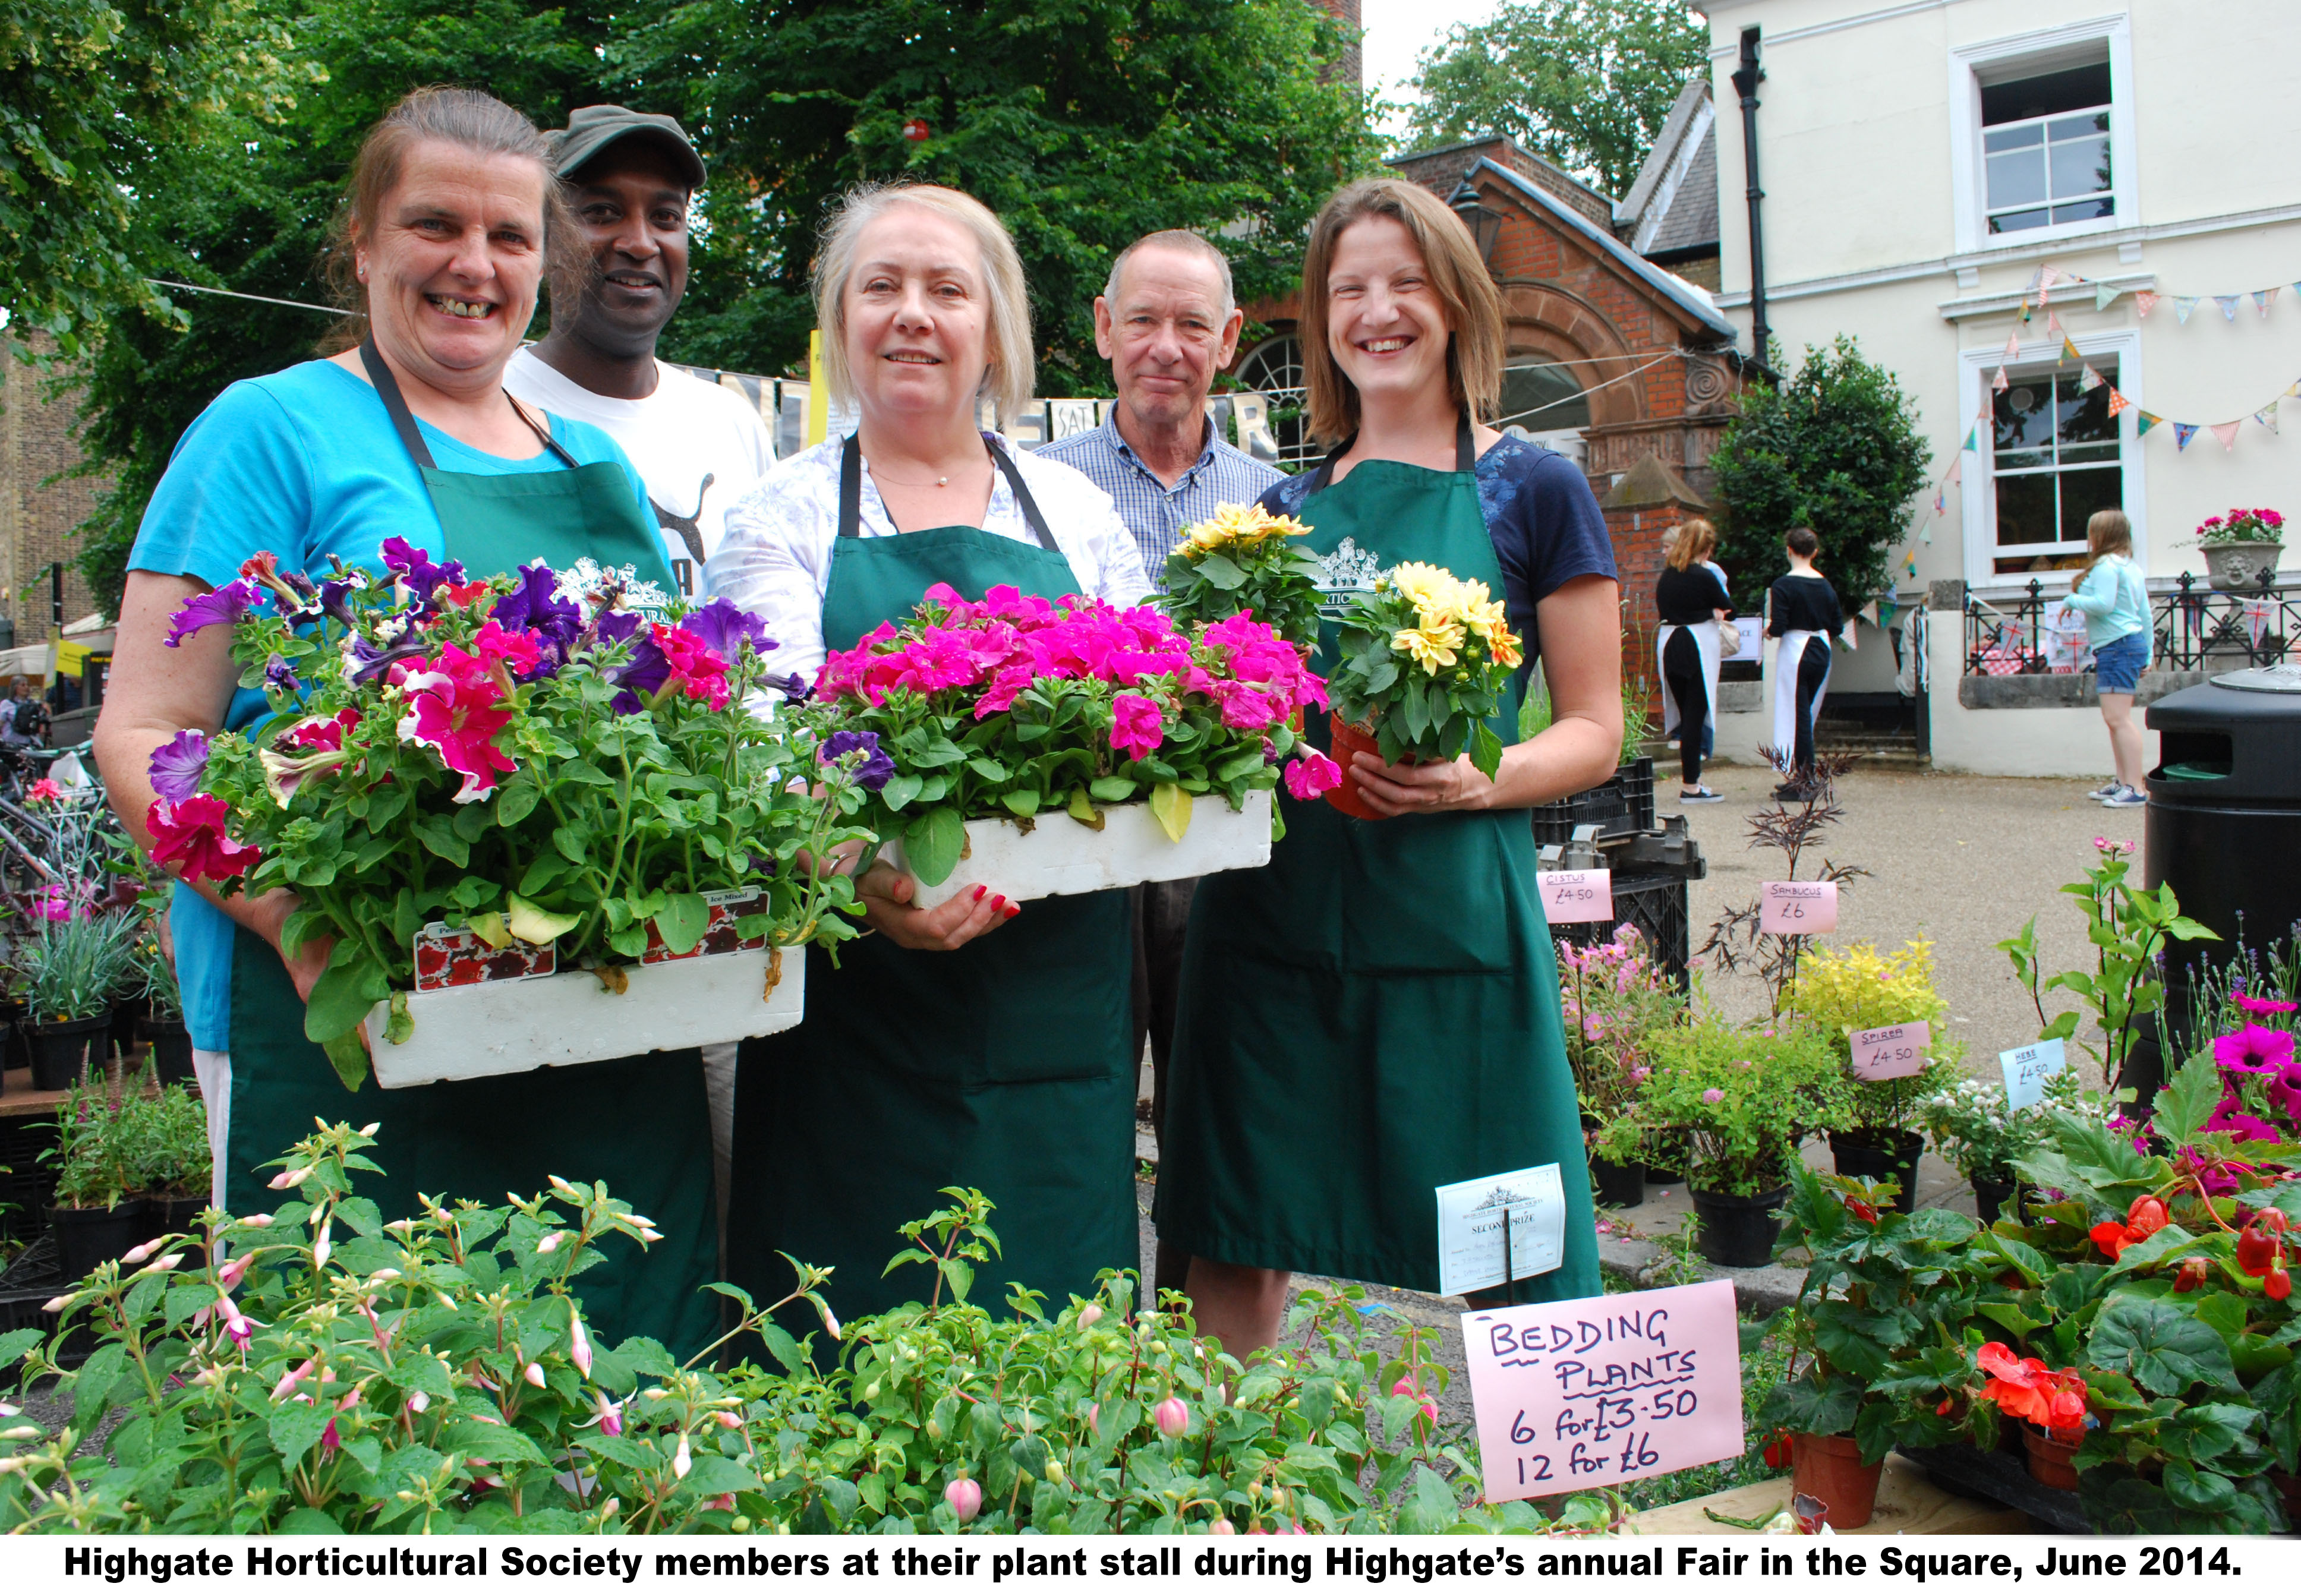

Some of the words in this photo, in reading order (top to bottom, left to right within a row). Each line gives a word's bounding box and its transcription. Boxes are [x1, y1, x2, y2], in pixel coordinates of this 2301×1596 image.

[1546, 873, 1585, 884] CISTUS
[724, 892, 748, 901] Mixed
[1555, 888, 1593, 904] £4.50
[1770, 884, 1821, 896] SAMBUCUS
[1781, 902, 1804, 918] £6
[1861, 1029, 1903, 1043] SPIREA
[1870, 1047, 1912, 1067] £4.50
[2015, 1049, 2037, 1062] HEBE
[1471, 1219, 1505, 1234] SECON
[1510, 1213, 1535, 1226] PRIZE
[1490, 1308, 1668, 1357] BEDDING
[1553, 1349, 1697, 1390] PLANTS
[1510, 1409, 1536, 1444] 6
[1555, 1408, 1594, 1440] for
[1594, 1389, 1697, 1443] £3.50
[1517, 1454, 1553, 1485] 12
[1569, 1442, 1609, 1475] for
[1620, 1431, 1659, 1473] £6
